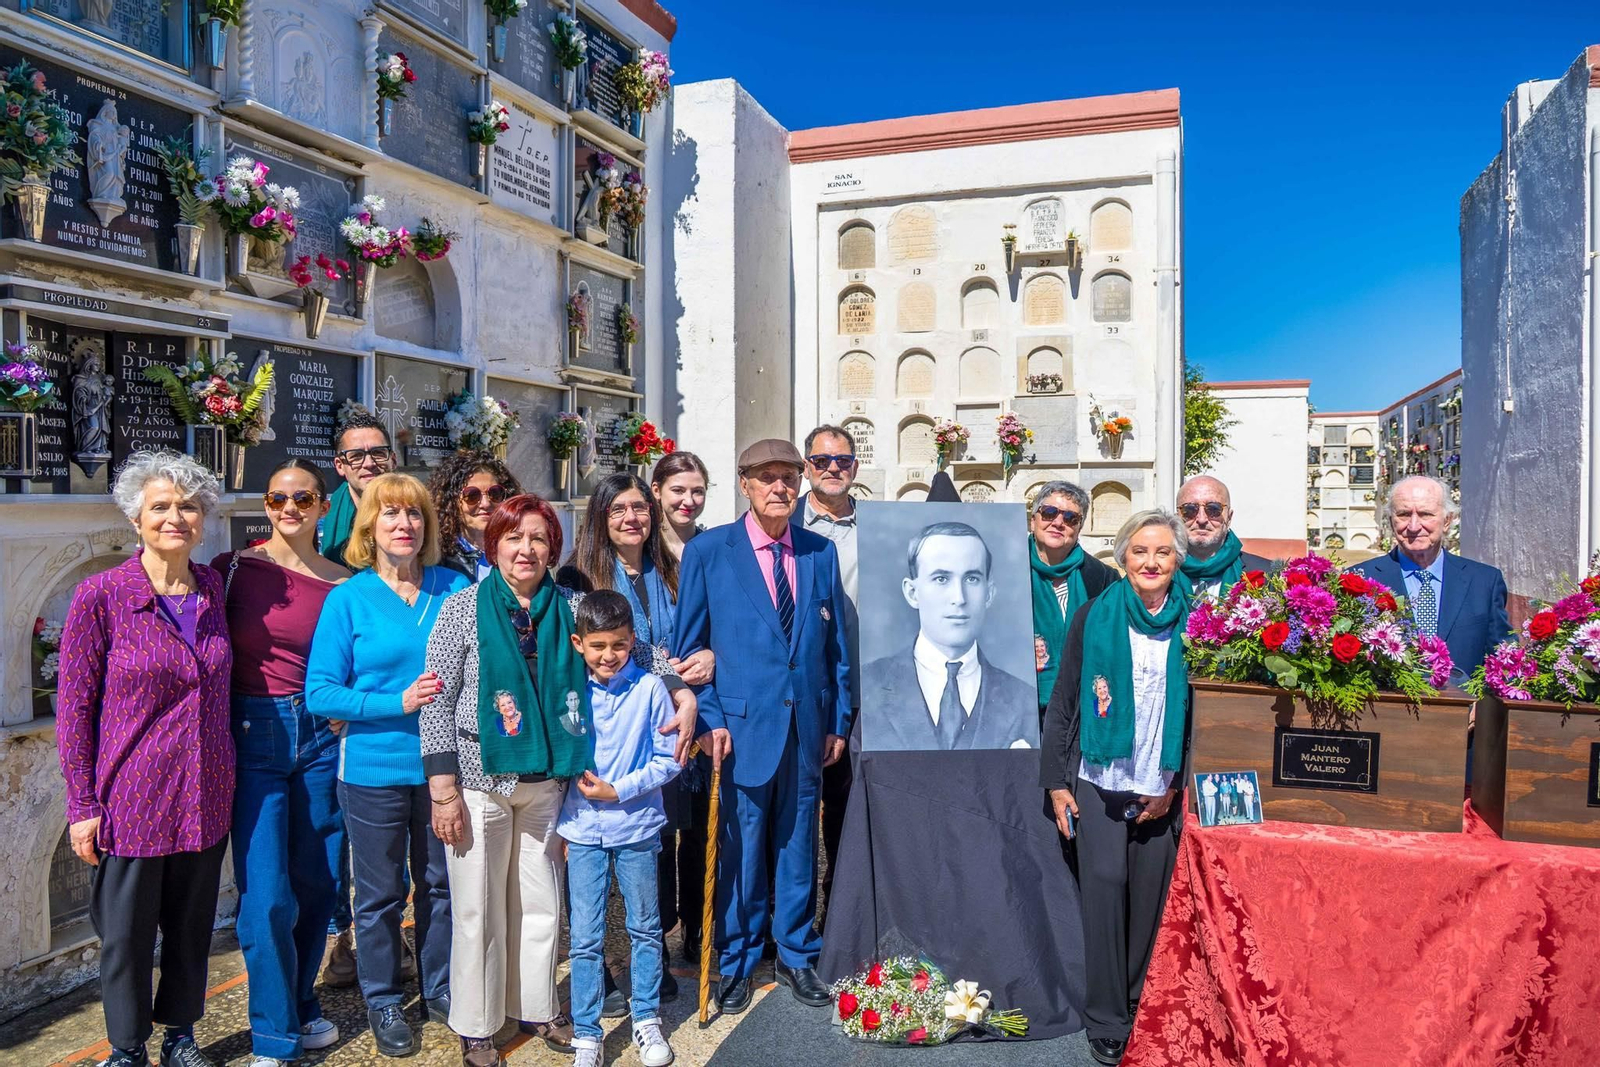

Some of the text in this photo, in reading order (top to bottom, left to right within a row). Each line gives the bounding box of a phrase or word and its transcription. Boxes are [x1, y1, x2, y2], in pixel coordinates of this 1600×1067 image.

[76, 76, 126, 100] PROPIEDAD 24
[130, 166, 158, 186] PRIAN
[55, 180, 68, 190] LOS
[827, 180, 861, 188] IGNACIO
[53, 192, 74, 208] AÑOS
[134, 201, 154, 214] A LOS
[141, 216, 159, 229] AÑOS
[64, 220, 140, 246] Y RESTOS DE FAMILIA
[58, 231, 147, 258] NUNCA OS OLVIDAREMOS
[44, 291, 211, 328] PROPIEDAD 23
[127, 340, 140, 353] R.
[166, 344, 175, 356] P.
[38, 348, 68, 362] ONZALO
[122, 354, 176, 370] D. DIEGO
[299, 360, 328, 374] MARIA
[290, 373, 334, 389] GONZALEZ
[293, 388, 334, 402] MARQUEZ
[148, 407, 170, 416] LOS
[416, 398, 449, 412] FAMILIA
[40, 414, 67, 428] JOSEFA
[128, 416, 175, 426] 79 AÑOS
[120, 426, 180, 439] VICTORIA
[295, 425, 300, 433] Y
[301, 426, 322, 434] RESTOS
[415, 434, 449, 447] EXPERT
[37, 452, 63, 463] ASILIO
[287, 448, 335, 458] VUESTRA FAMILI
[246, 525, 272, 533] PROPIE
[1311, 744, 1340, 753] JUAN
[1301, 753, 1351, 764] MANTERO
[1304, 763, 1346, 774] VALERO
